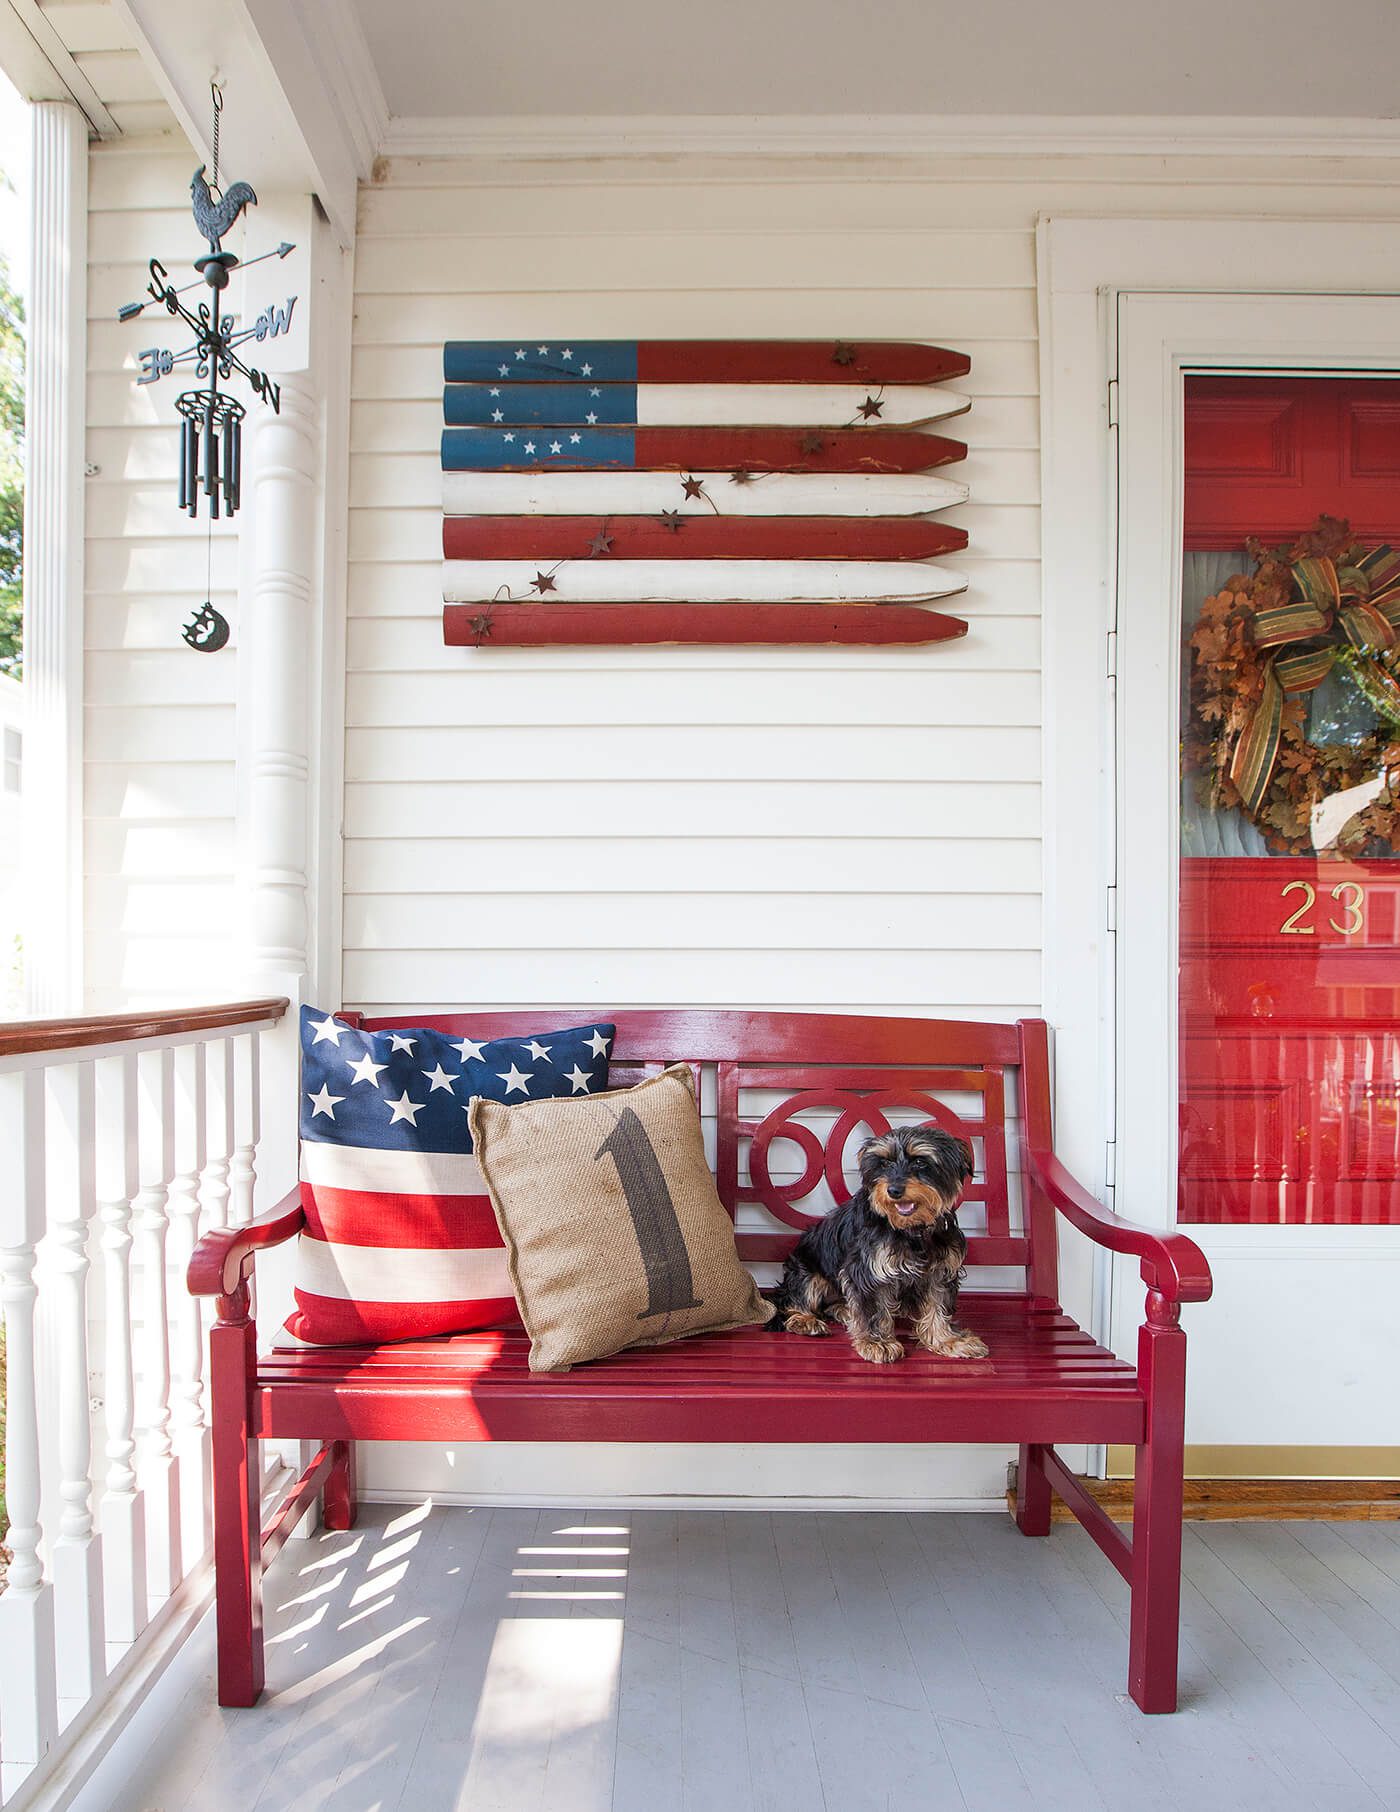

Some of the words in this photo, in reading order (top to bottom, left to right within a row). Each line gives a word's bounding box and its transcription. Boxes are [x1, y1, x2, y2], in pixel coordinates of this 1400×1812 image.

[147, 258, 167, 303] S
[265, 296, 298, 338] W
[260, 372, 281, 415] N
[1280, 880, 1364, 935] 23
[594, 1106, 704, 1320] 1
